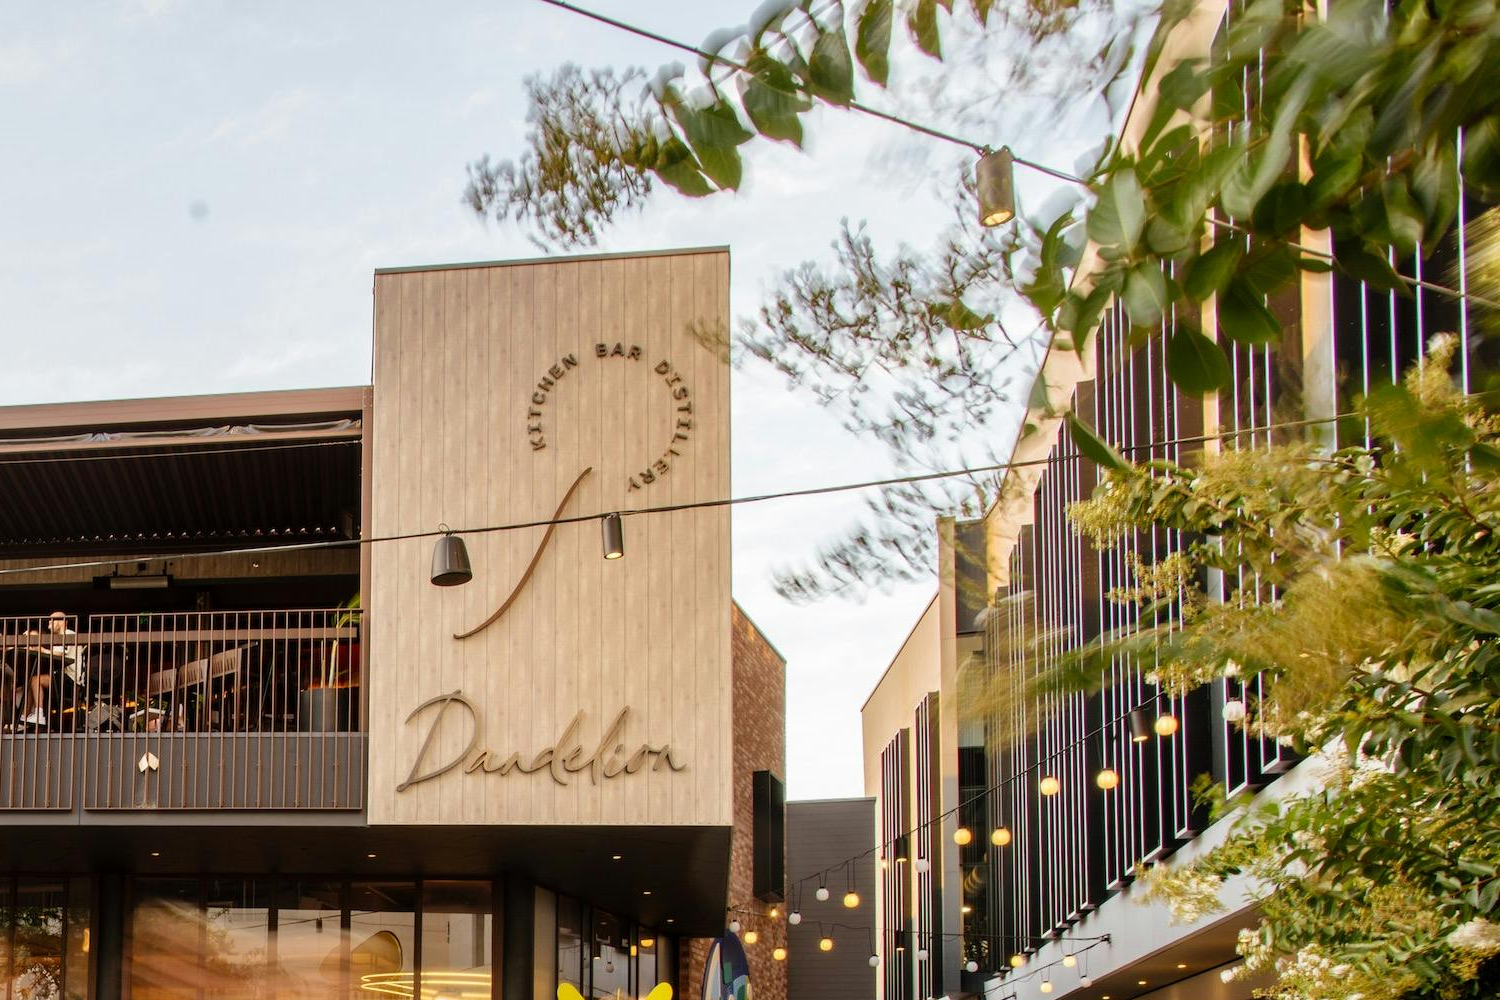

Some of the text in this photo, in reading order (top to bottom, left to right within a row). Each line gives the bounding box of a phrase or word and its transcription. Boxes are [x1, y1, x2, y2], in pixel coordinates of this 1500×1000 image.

[527, 342, 693, 493] KITCHEN BAR DISTILLERY
[396, 689, 687, 793] Dandelion
